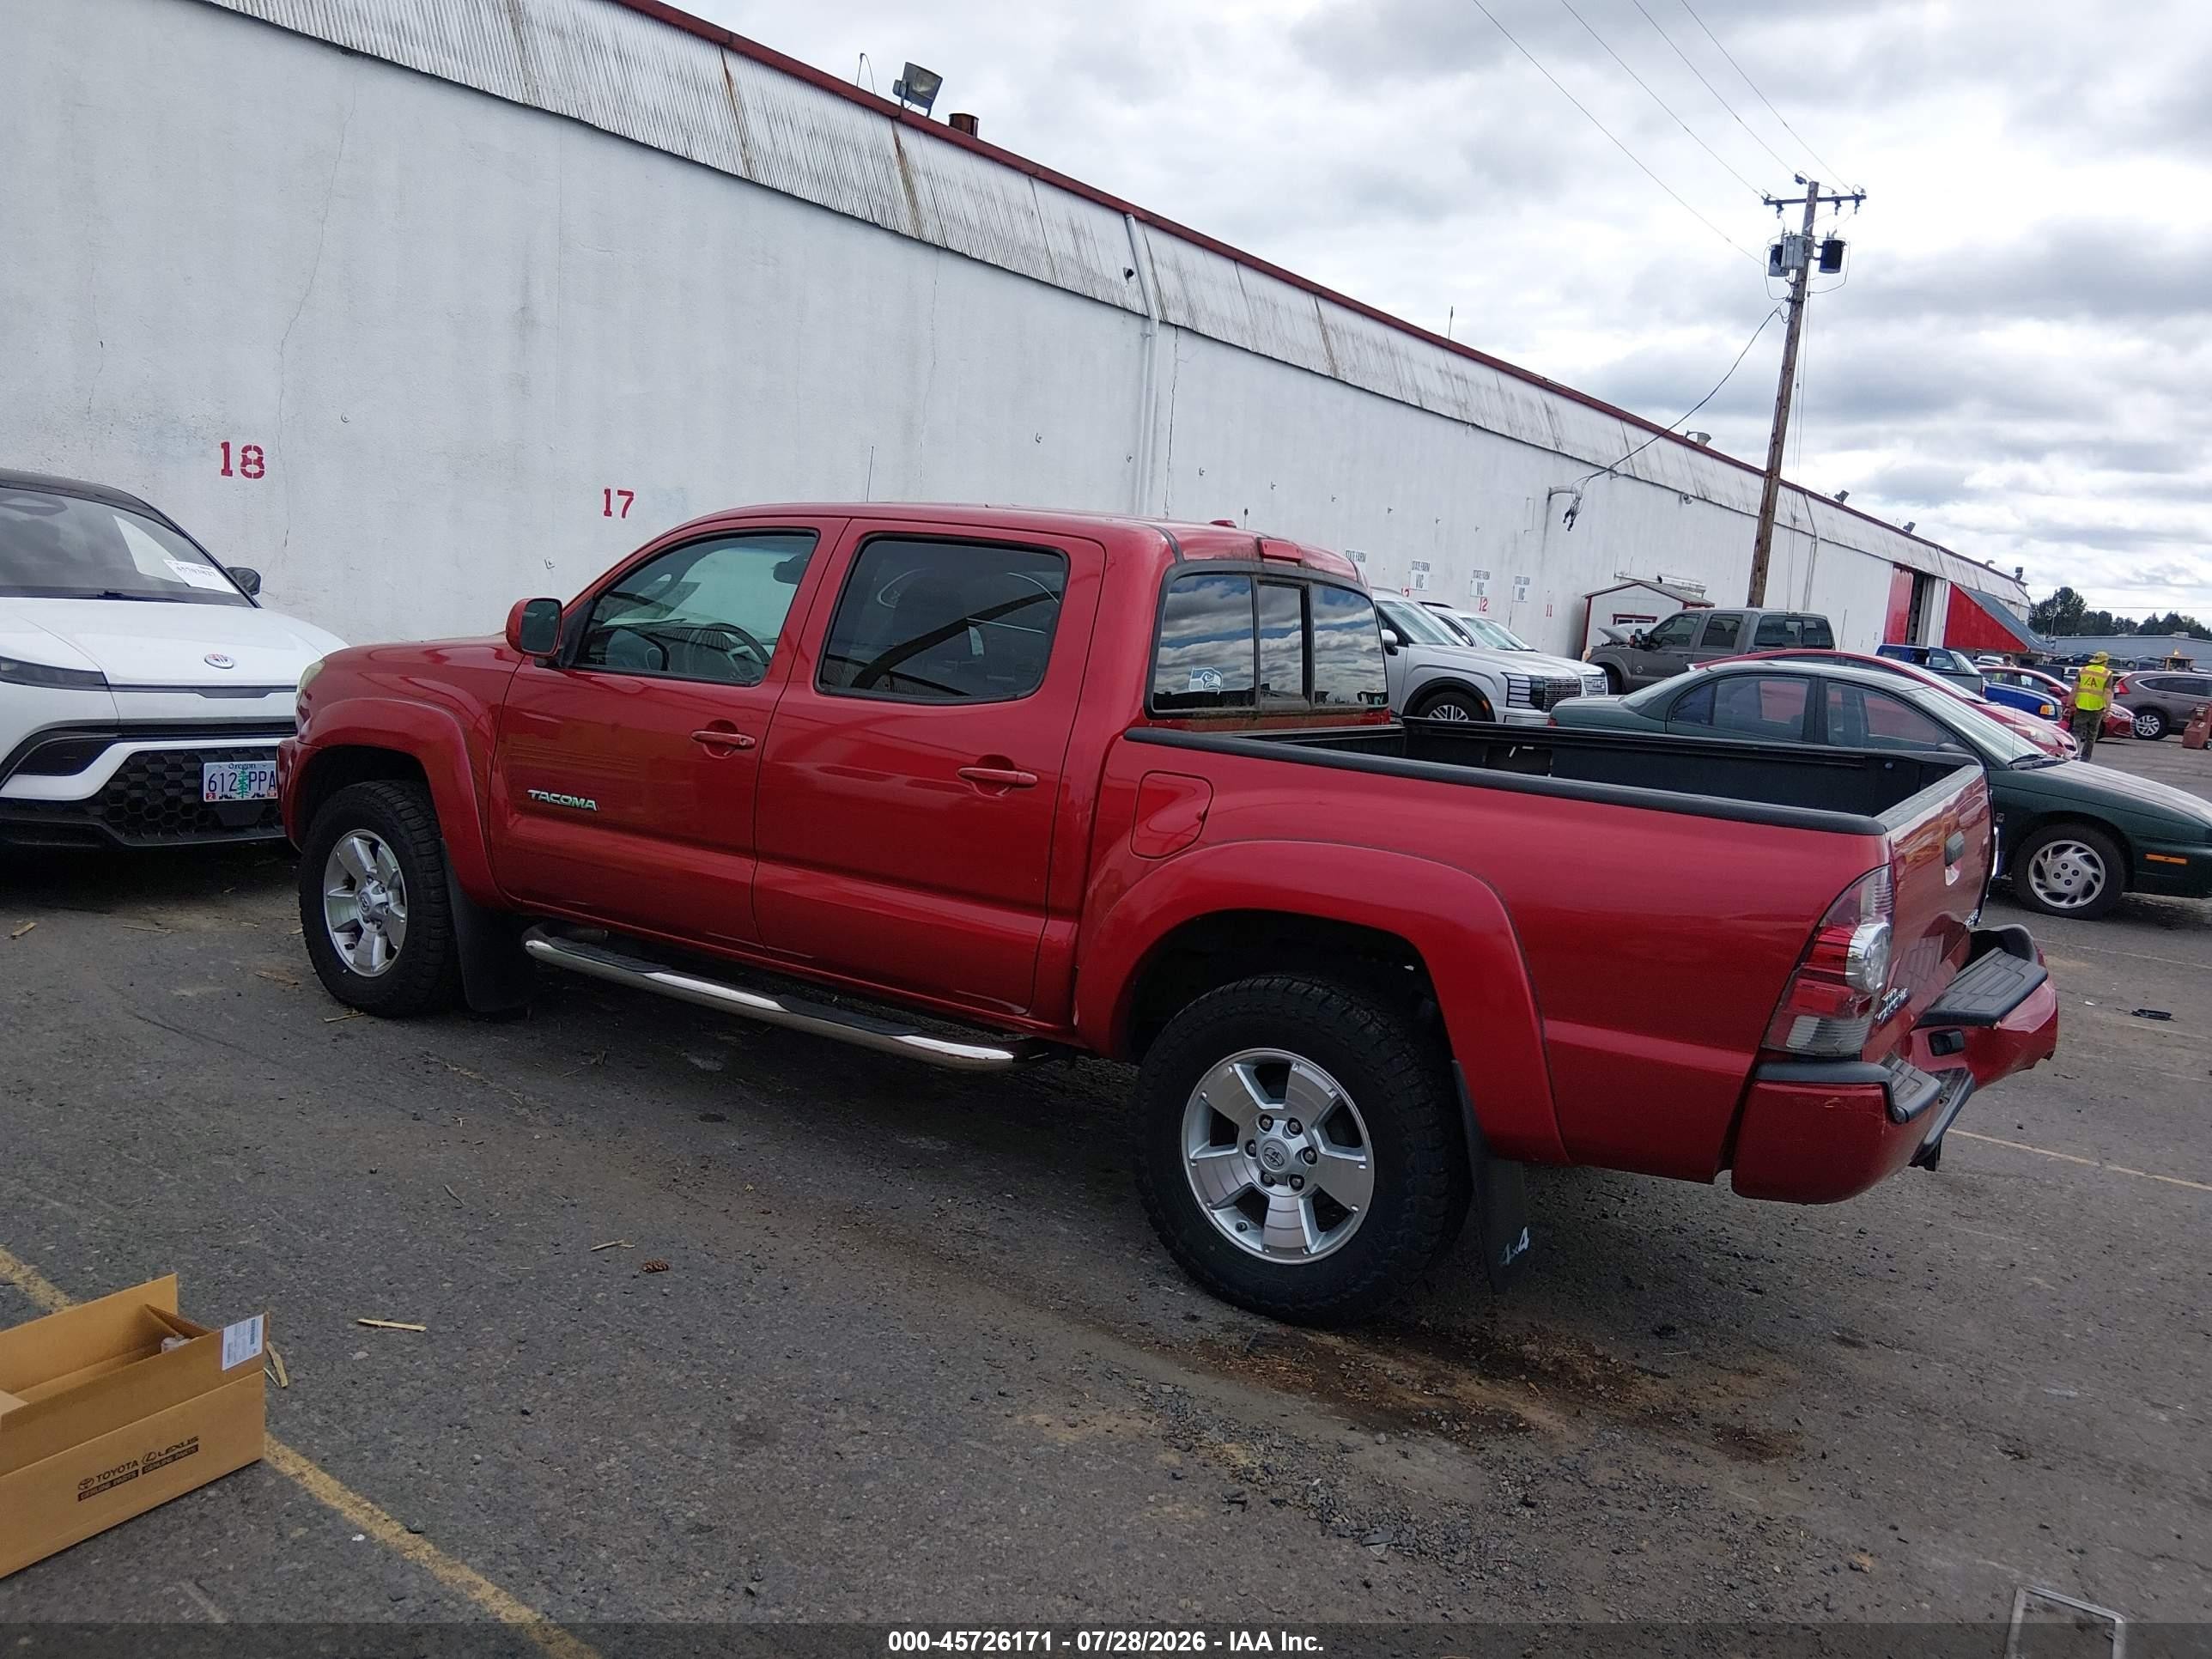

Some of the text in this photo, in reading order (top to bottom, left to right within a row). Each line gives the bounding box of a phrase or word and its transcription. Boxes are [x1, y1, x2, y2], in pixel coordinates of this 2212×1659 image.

[220, 441, 264, 479] 18
[604, 488, 635, 519] 17
[1479, 596, 1488, 612] 12
[208, 770, 276, 793] 612 PPA
[527, 789, 598, 811] TACOMA
[158, 1435, 199, 1457] LEXUS
[96, 1459, 138, 1483] TOYOTA
